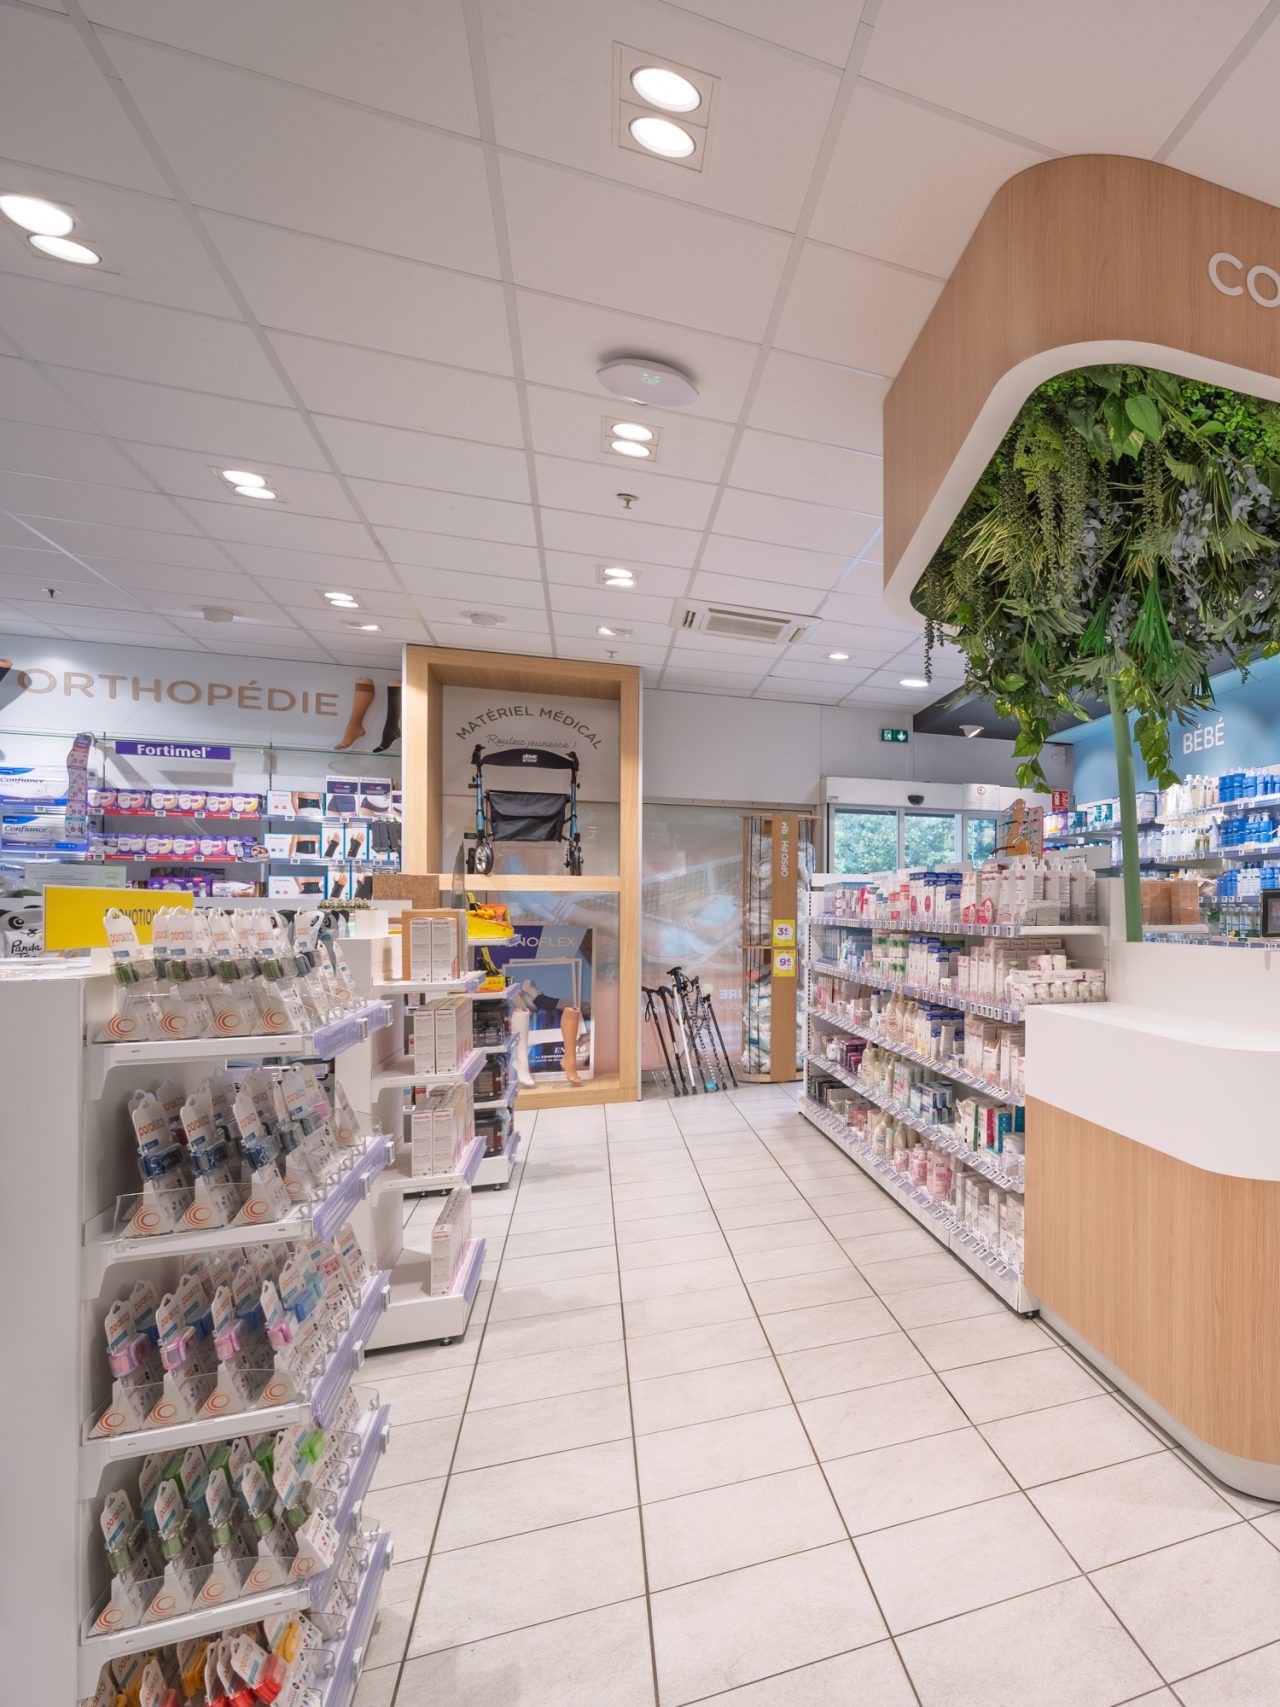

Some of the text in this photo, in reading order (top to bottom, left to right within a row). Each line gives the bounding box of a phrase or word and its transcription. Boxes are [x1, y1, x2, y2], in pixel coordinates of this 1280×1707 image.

[17, 668, 339, 716] ORTHOPÉDIE
[456, 706, 604, 749] MATÉRIEL MÉDICAL
[1182, 717, 1225, 755] BÉBÉ
[1, 776, 45, 784] Confiance
[4, 825, 48, 833] Confiance
[11, 940, 43, 954] Panda
